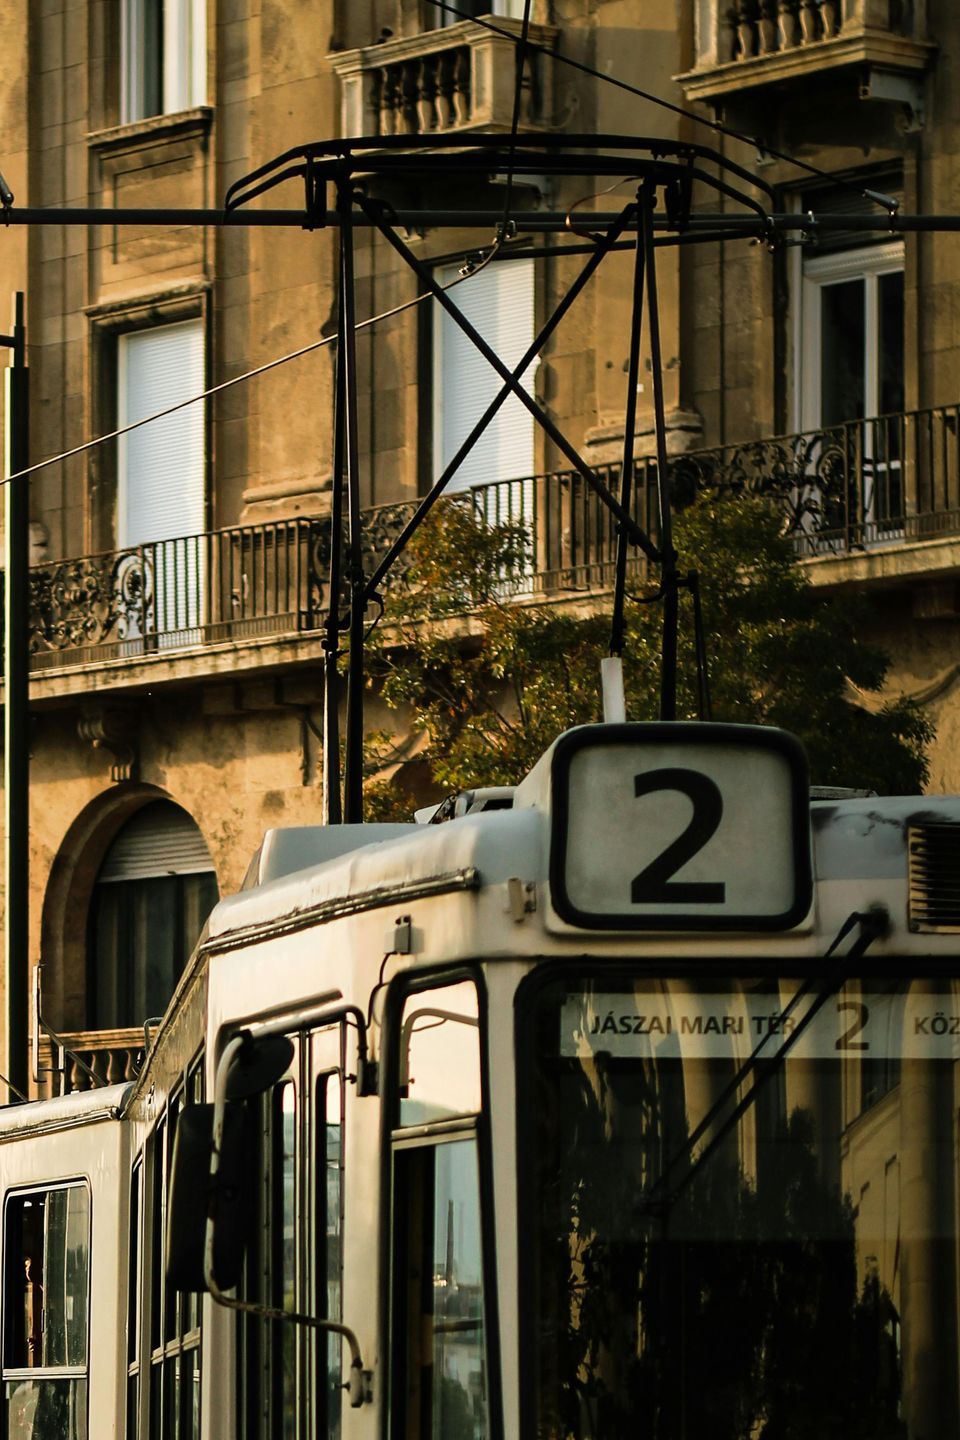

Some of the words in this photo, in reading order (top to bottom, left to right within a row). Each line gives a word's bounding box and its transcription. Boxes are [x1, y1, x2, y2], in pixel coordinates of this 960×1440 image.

[631, 768, 725, 904] 2
[591, 1011, 672, 1035] JÁSZAI
[681, 1016, 744, 1035] MARI
[752, 1012, 797, 1035] TÉR
[836, 1001, 869, 1050] 2
